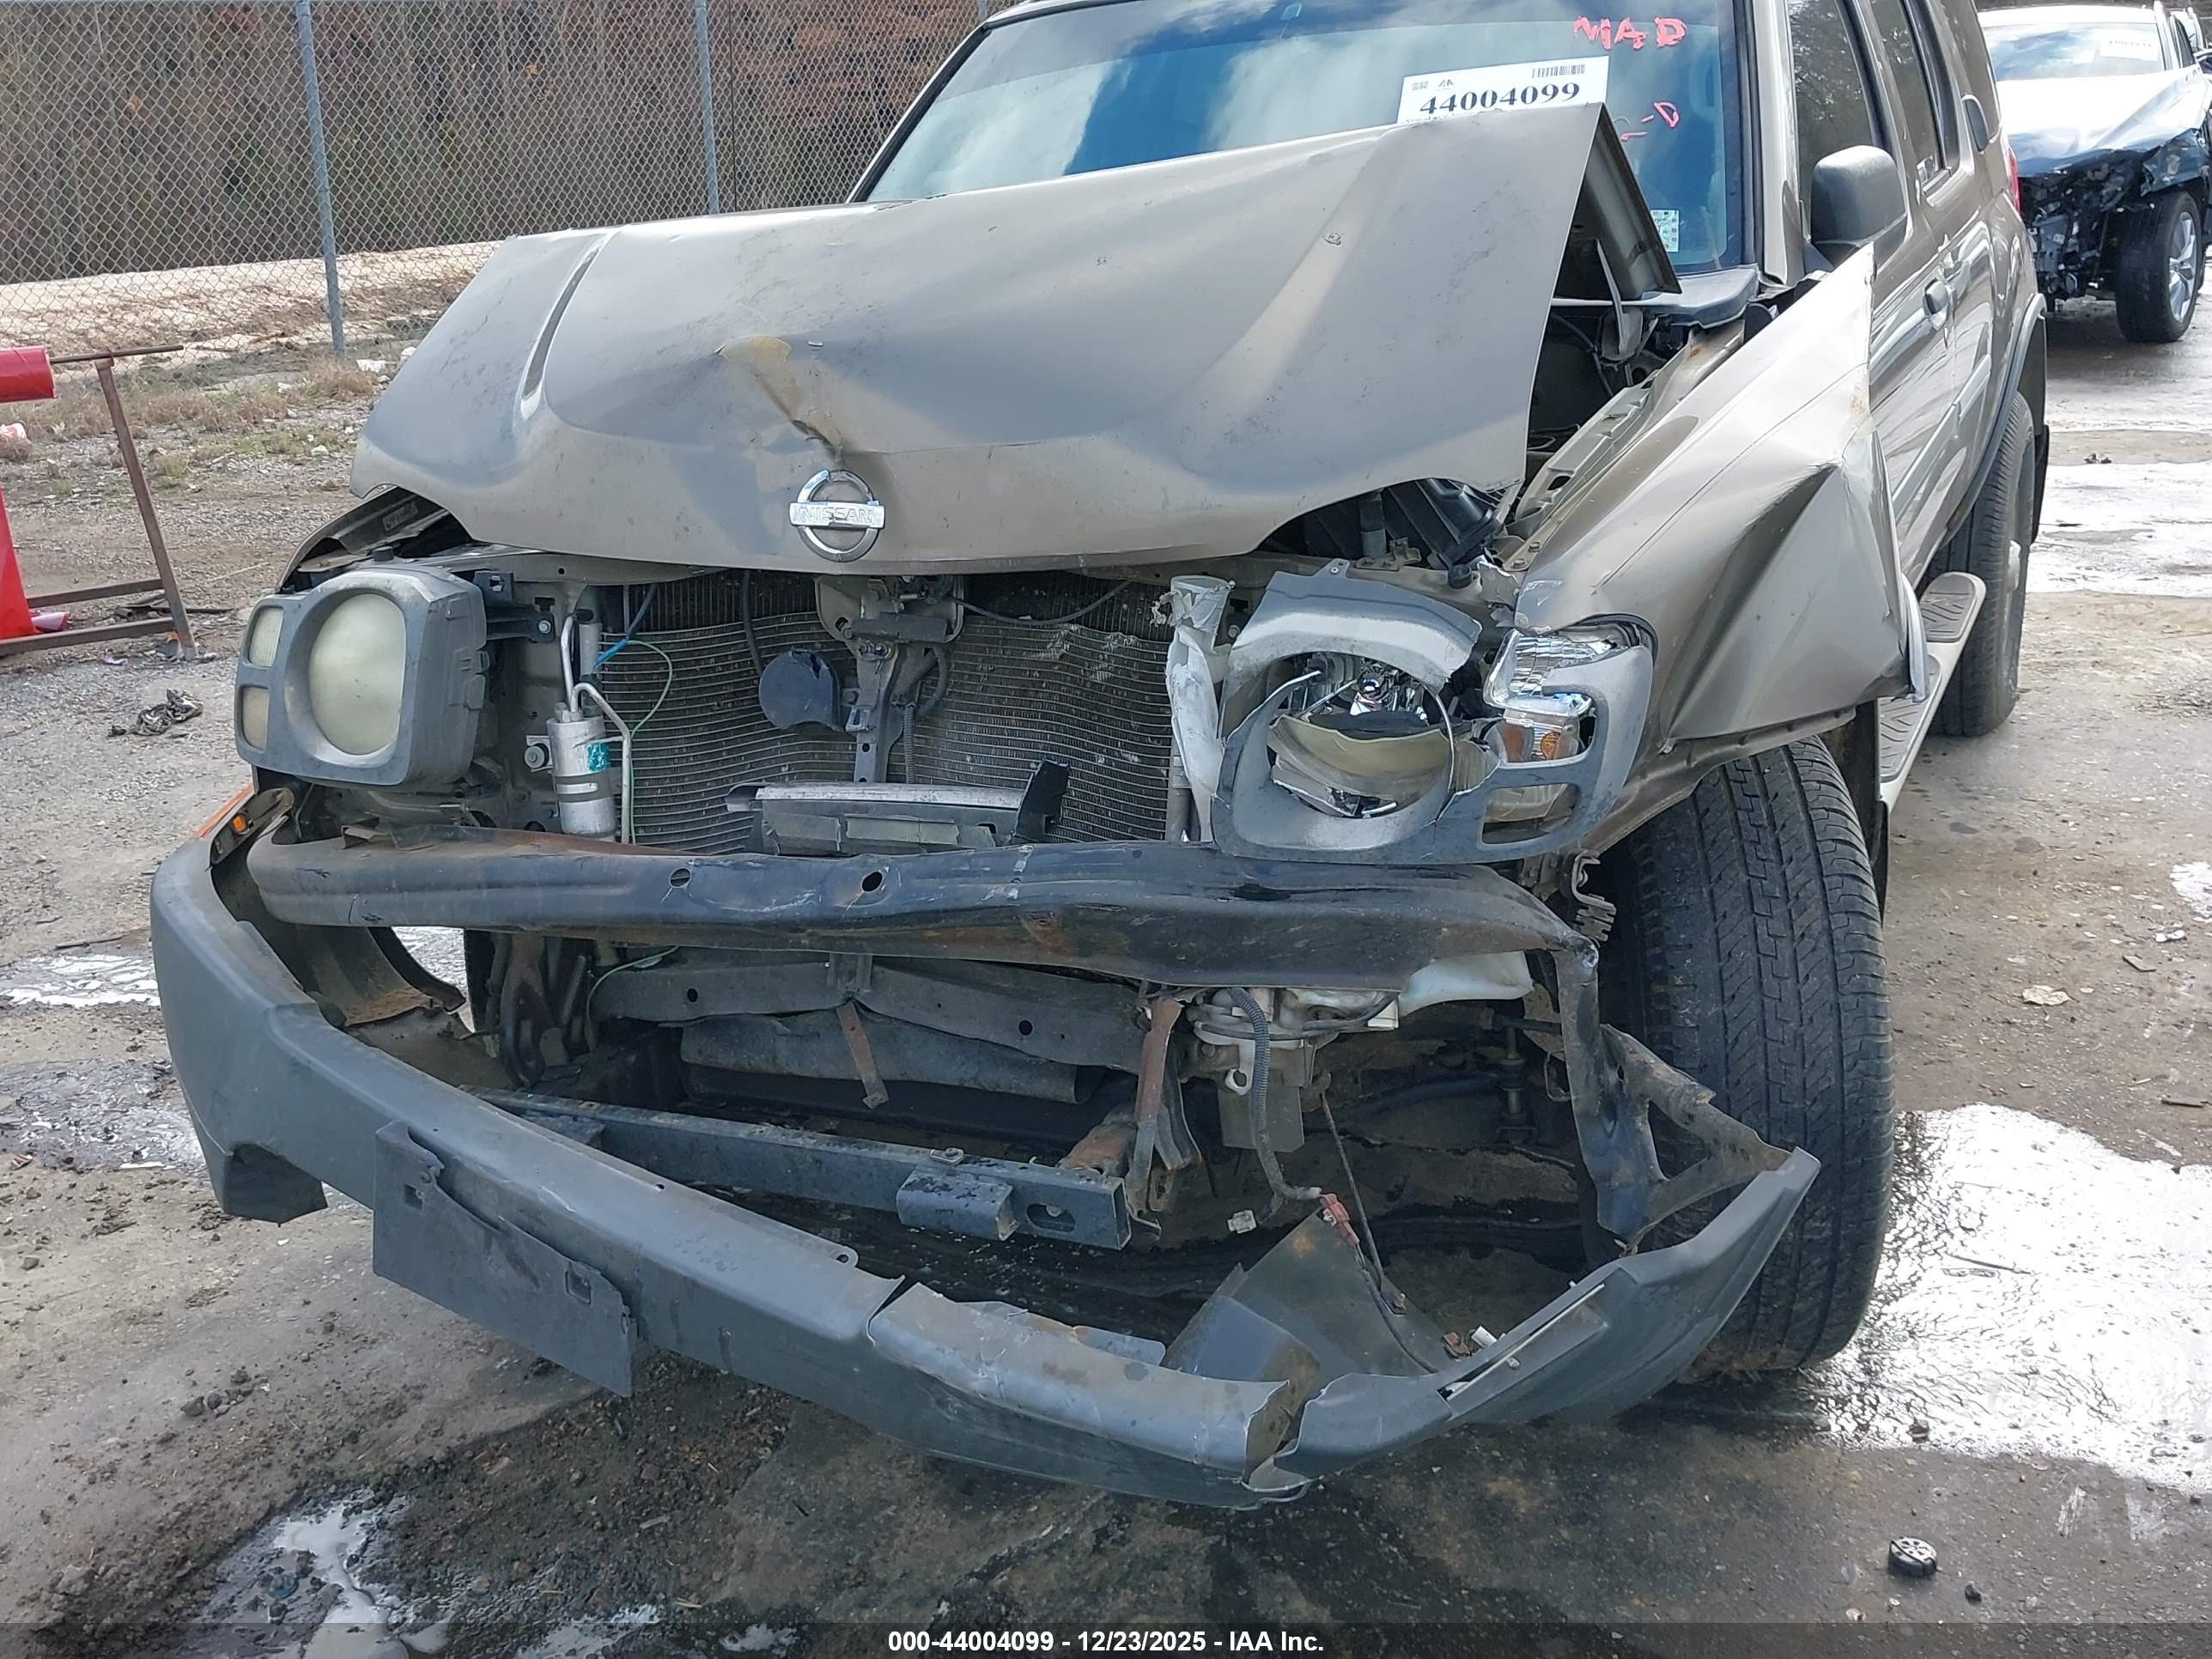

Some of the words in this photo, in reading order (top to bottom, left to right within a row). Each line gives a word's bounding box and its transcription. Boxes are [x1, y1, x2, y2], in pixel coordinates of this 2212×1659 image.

[1574, 16, 1686, 50] MAD
[1419, 82, 1580, 114] 44004099
[798, 507, 872, 524] NISSAN
